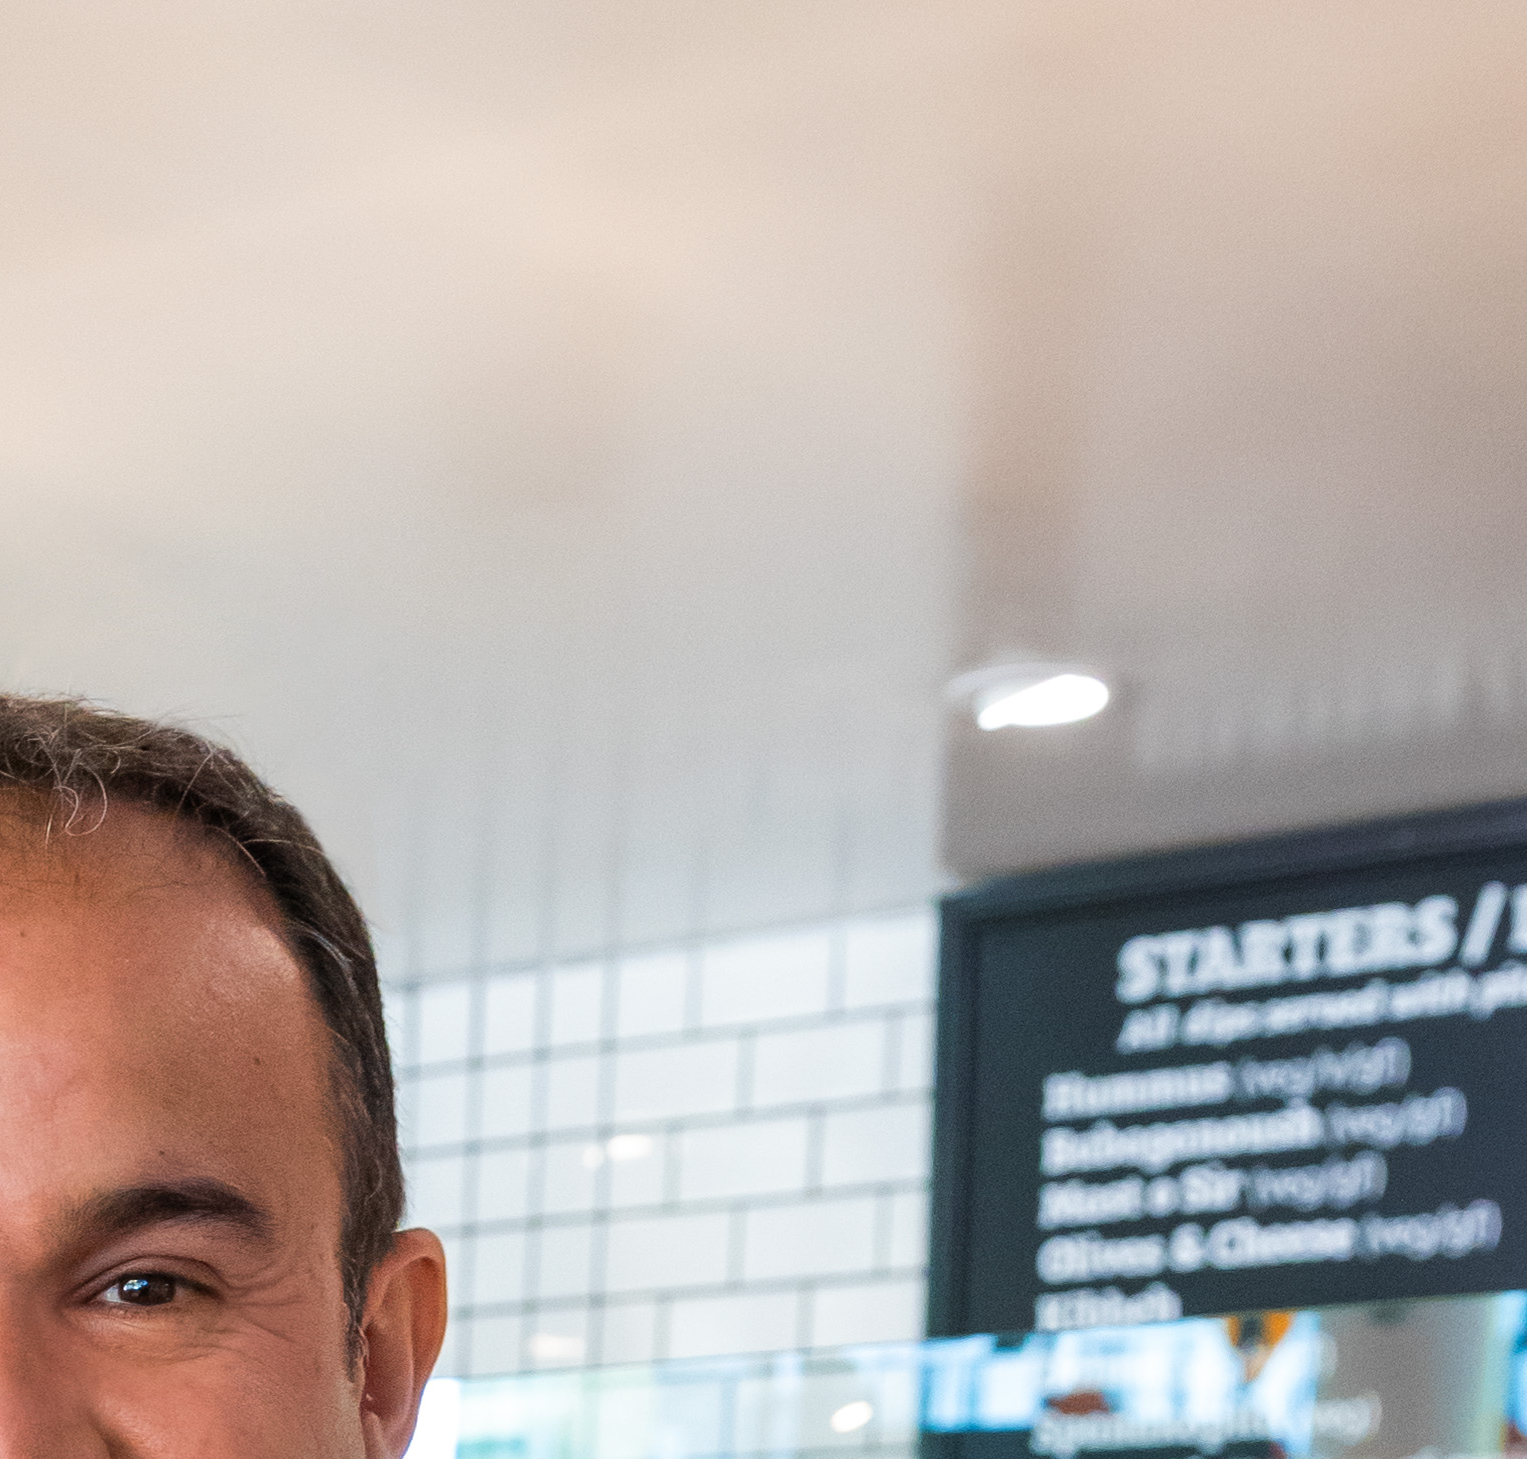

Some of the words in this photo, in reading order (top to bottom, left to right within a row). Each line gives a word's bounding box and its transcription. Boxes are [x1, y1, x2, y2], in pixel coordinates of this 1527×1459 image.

[1117, 894, 1458, 1002] STARTERS
[1042, 1060, 1233, 1122] Hummus
[1036, 1232, 1167, 1285] Olives
[1208, 1215, 1357, 1272] Cheese
